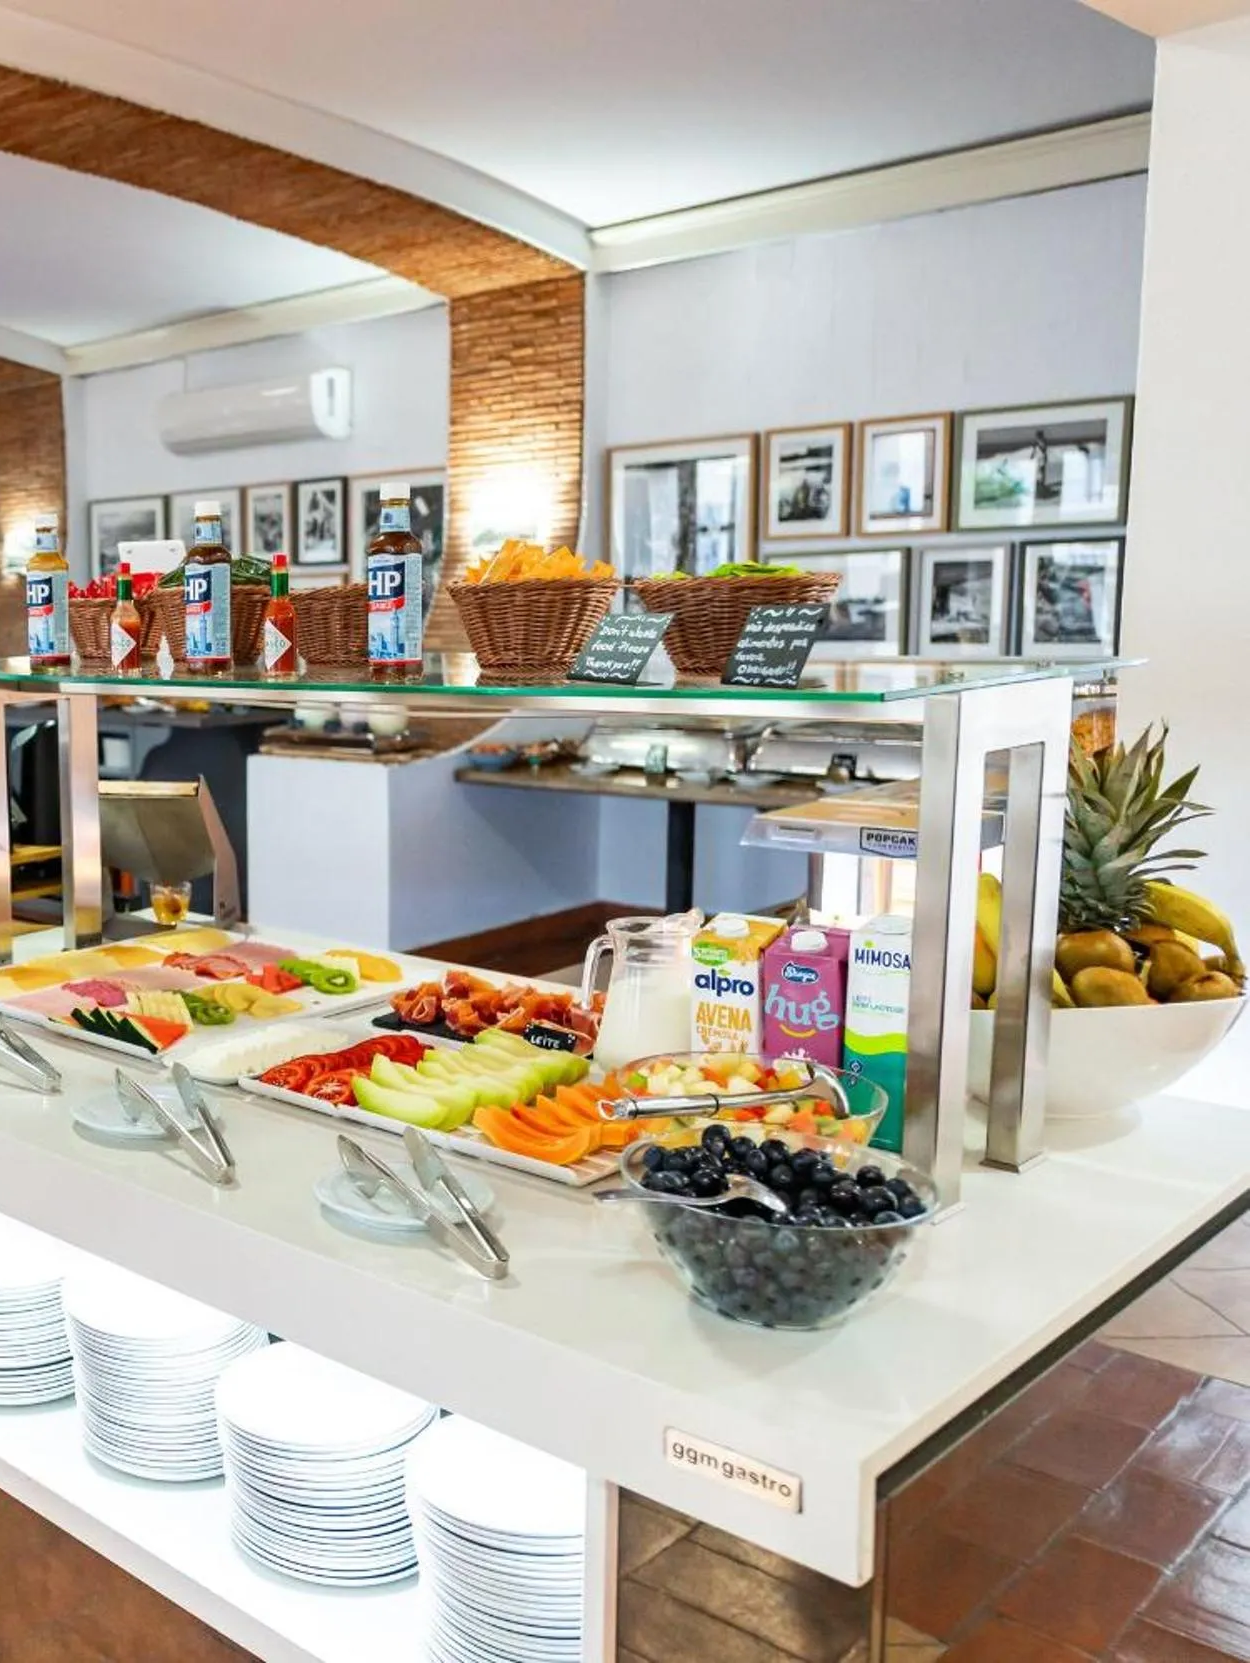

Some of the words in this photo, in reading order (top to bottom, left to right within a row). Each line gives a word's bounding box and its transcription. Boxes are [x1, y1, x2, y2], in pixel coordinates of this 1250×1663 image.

[26, 583, 50, 605] HP
[184, 578, 208, 601] HP
[368, 570, 402, 596] HP
[854, 948, 911, 970] MIMOSA
[694, 967, 754, 997] alpro
[695, 1001, 752, 1033] AVENA
[764, 983, 840, 1031] hug
